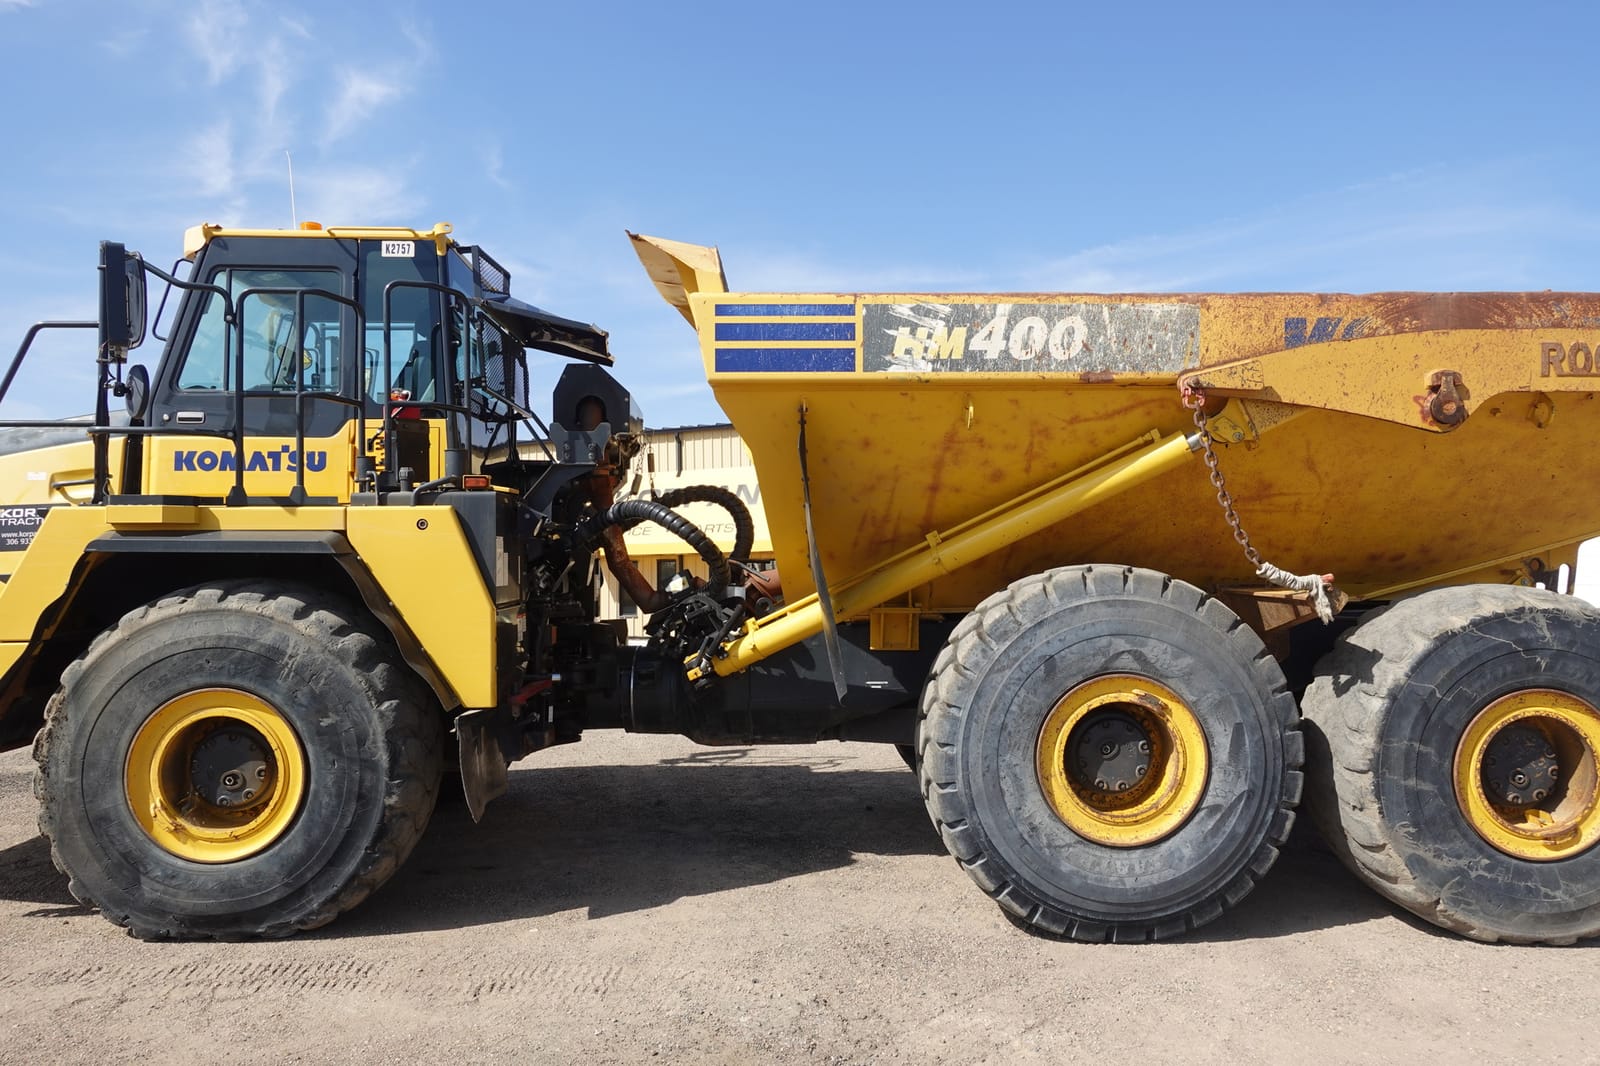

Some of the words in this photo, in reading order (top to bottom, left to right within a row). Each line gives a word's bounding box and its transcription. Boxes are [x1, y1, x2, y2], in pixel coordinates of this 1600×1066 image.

[385, 243, 411, 255] K2757
[1541, 342, 1600, 378] RO
[174, 445, 327, 472] KOMATSU
[1, 531, 36, 539] www.korp
[6, 538, 19, 546] 306
